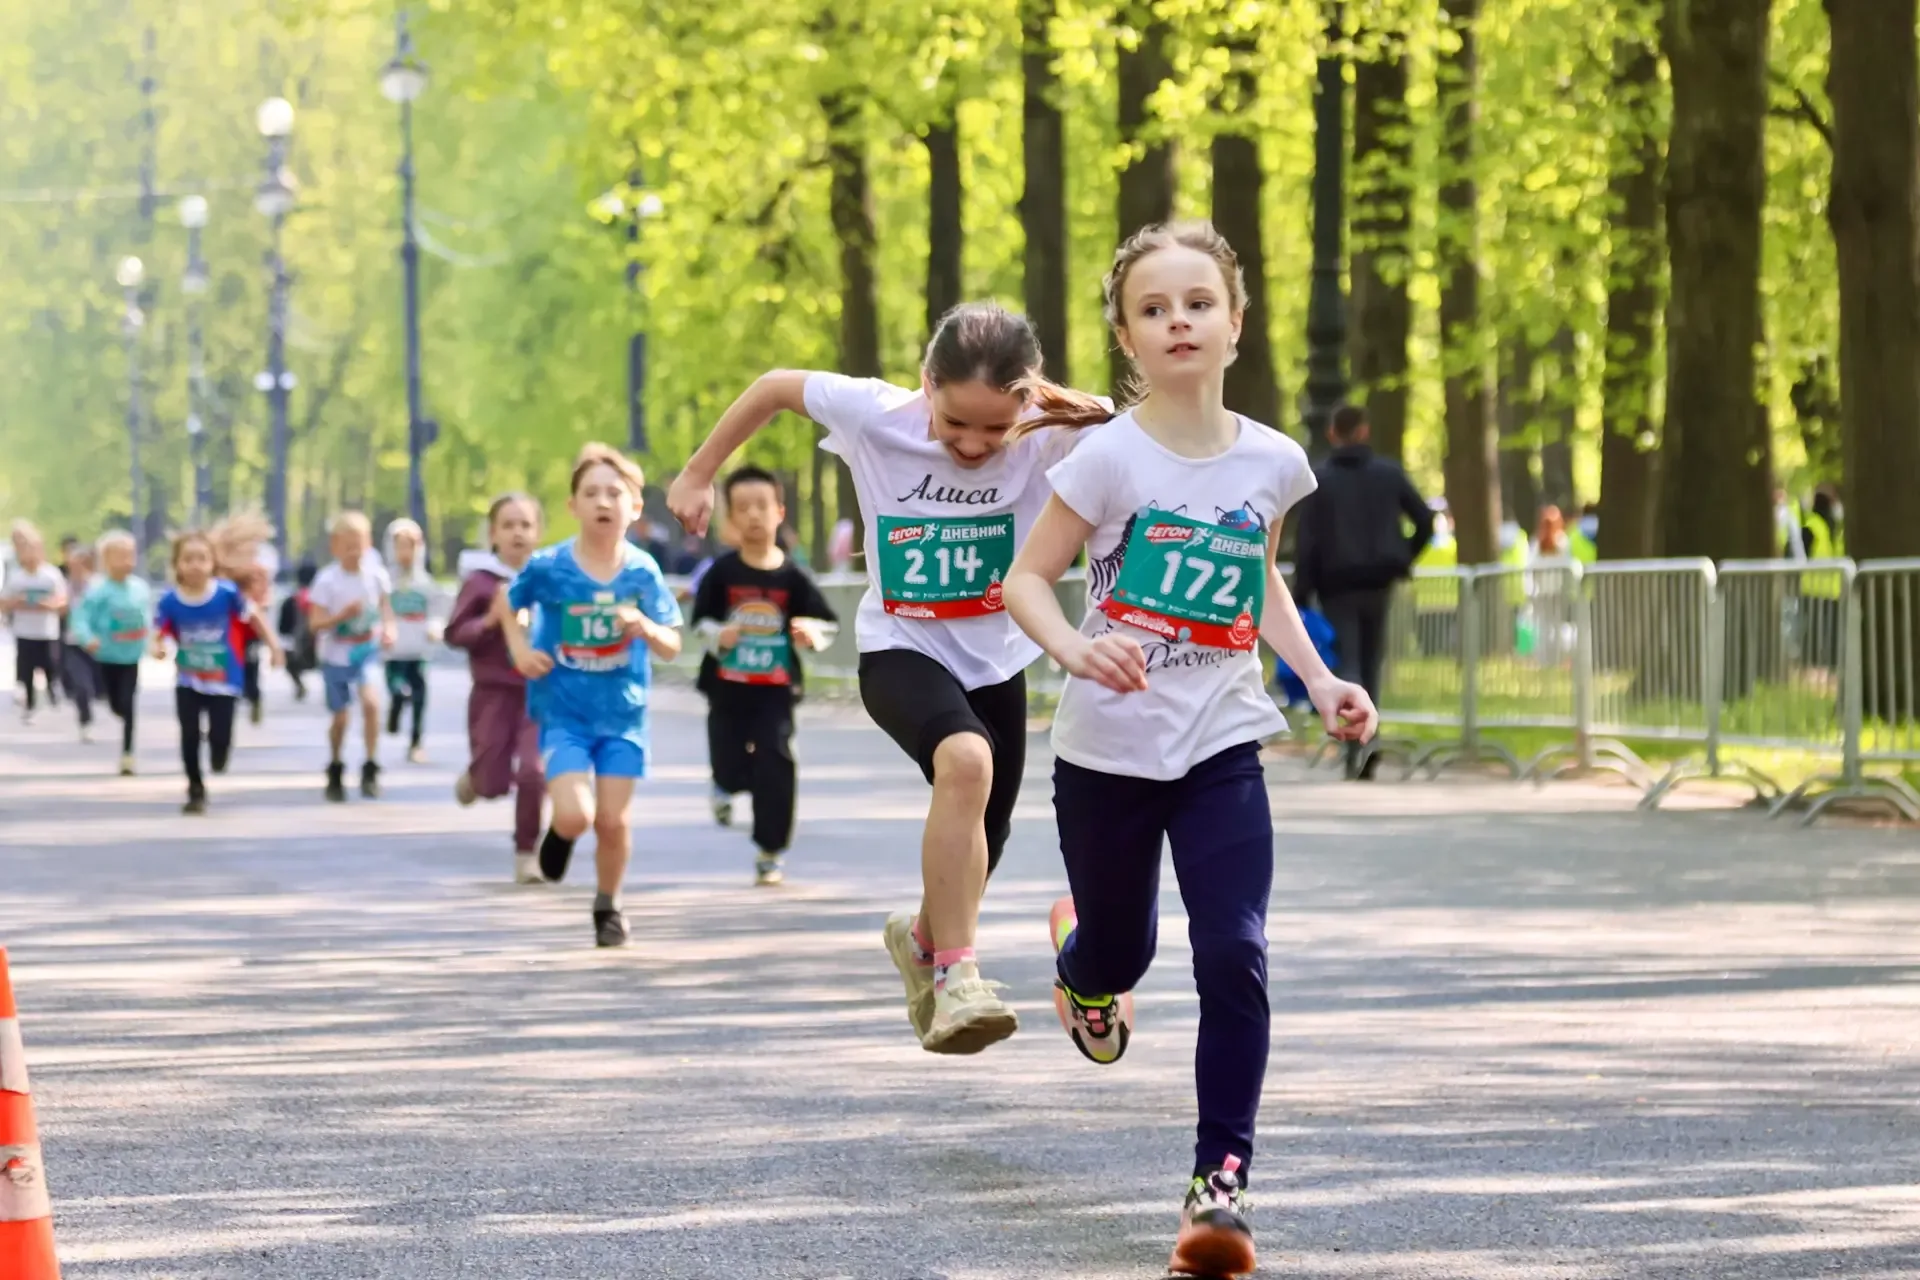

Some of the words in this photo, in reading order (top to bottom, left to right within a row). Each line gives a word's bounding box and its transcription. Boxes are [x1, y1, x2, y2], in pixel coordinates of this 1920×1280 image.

[897, 474, 1004, 504] Алиса
[888, 526, 923, 541] БЕГОМ
[940, 524, 1007, 541] ДНЕВНИК
[1144, 526, 1192, 538] БЕГОМ
[904, 545, 983, 586] 214
[1160, 551, 1242, 607] 172
